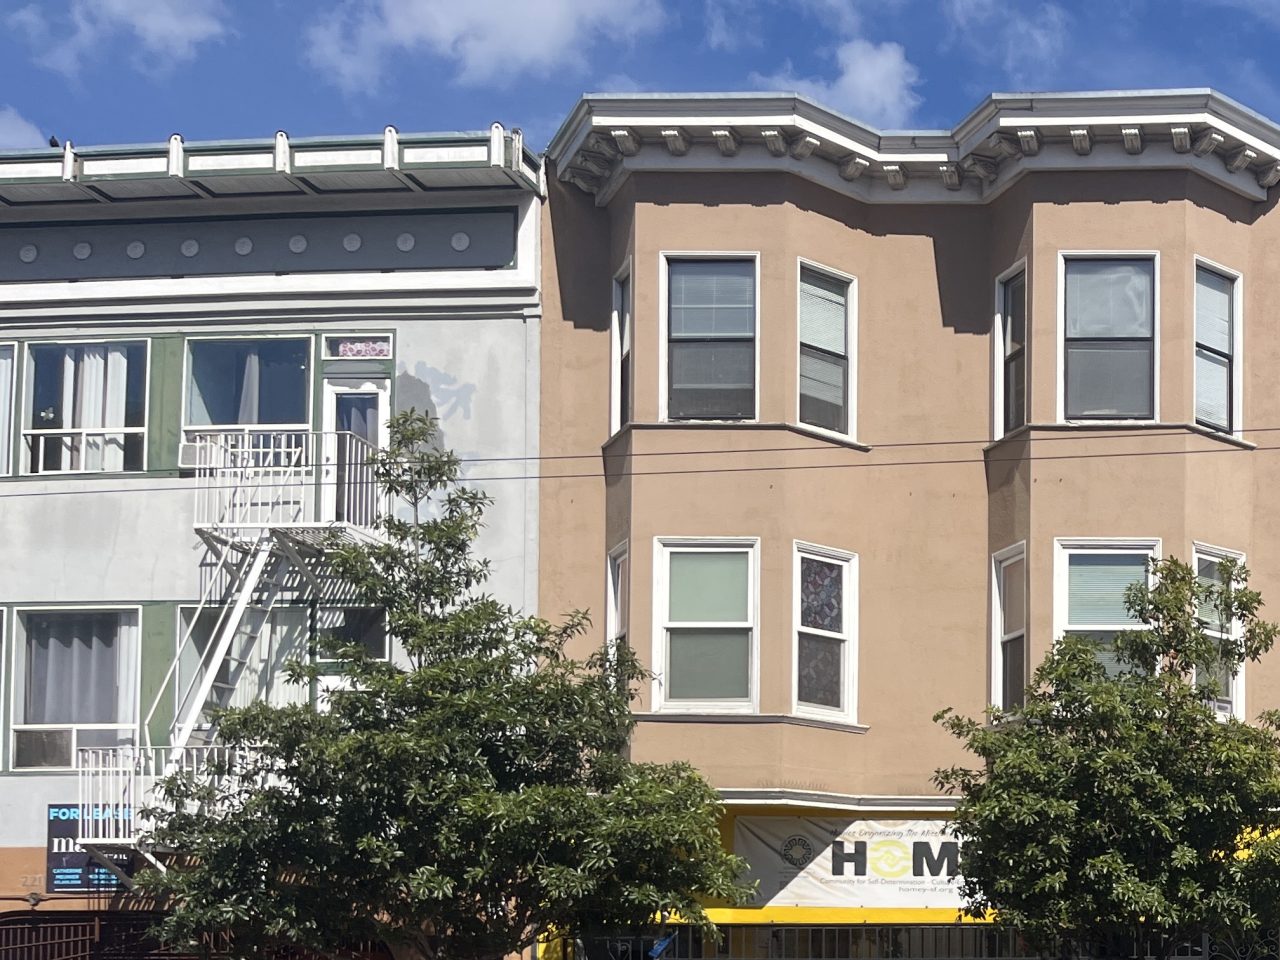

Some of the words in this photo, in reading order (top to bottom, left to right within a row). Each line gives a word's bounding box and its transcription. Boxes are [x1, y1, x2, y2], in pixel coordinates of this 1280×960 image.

[49, 808, 79, 820] FOR
[831, 839, 959, 877] HOM
[856, 877, 867, 885] for
